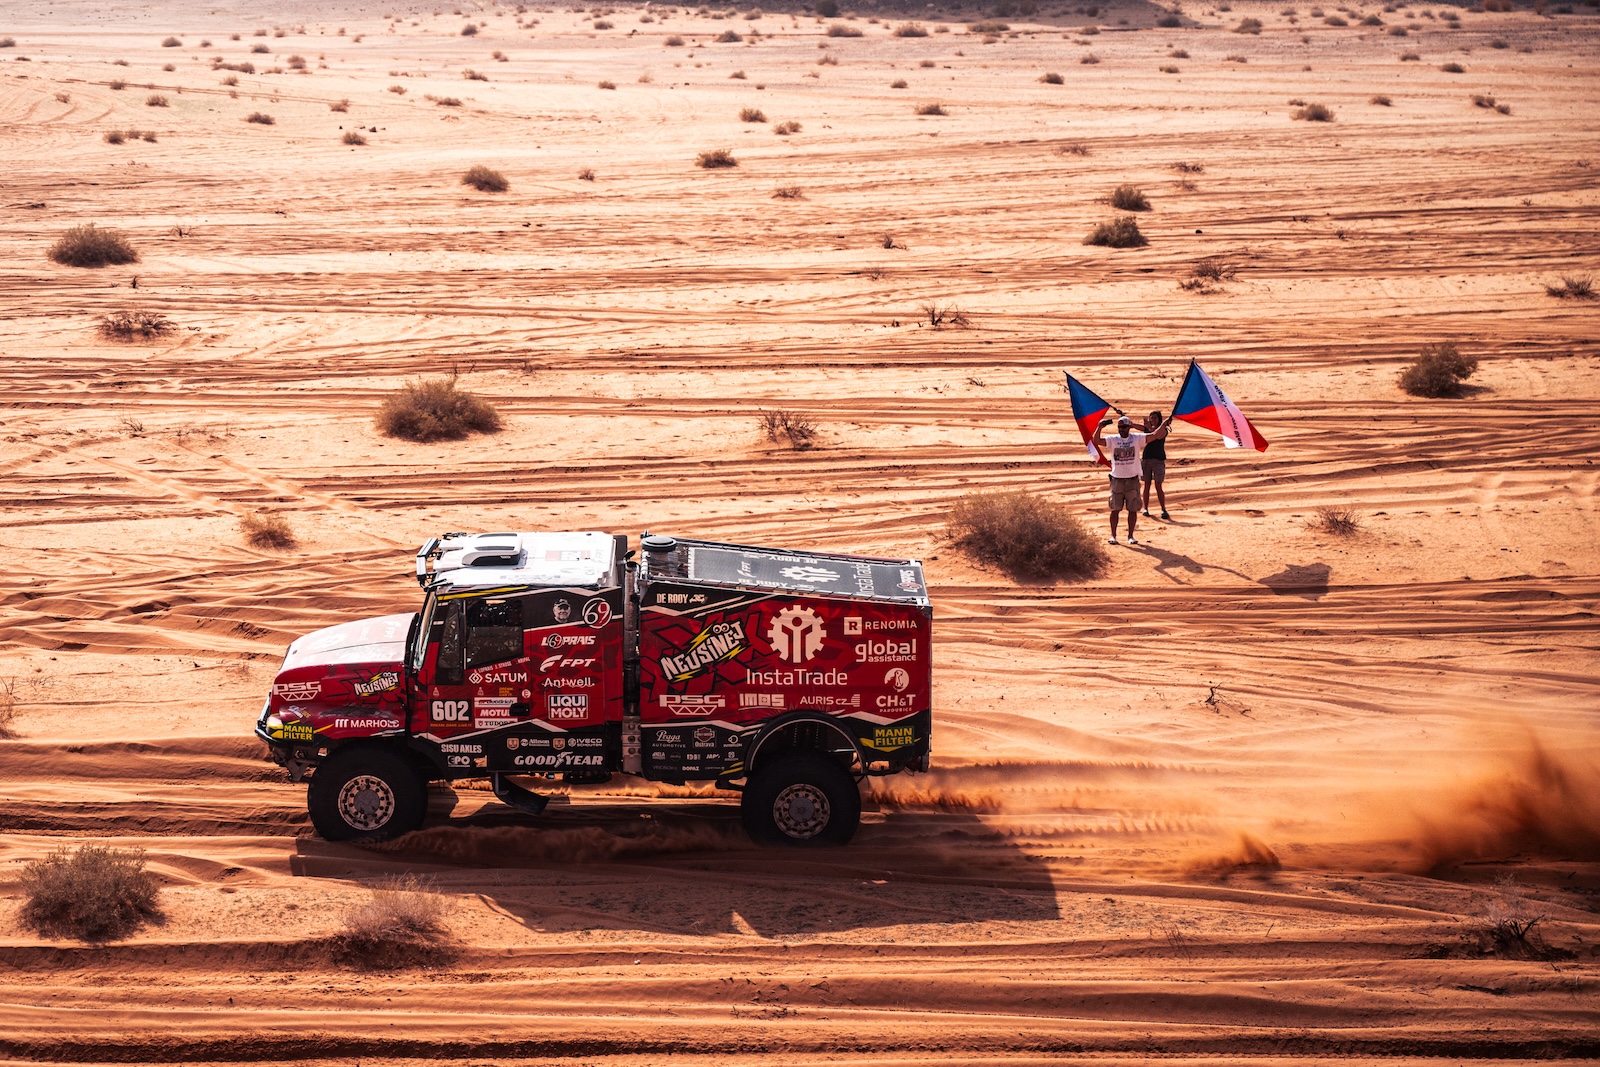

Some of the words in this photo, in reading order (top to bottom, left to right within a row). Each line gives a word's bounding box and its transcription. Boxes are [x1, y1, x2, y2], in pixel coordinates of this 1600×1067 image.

[656, 593, 666, 604] DE
[668, 593, 689, 604] ROOY
[583, 601, 611, 627] 69
[864, 619, 918, 630] RENOMIA
[855, 638, 917, 663] global
[560, 658, 596, 668] FPT
[868, 654, 917, 663] assistance
[485, 672, 528, 683] SATUM
[746, 667, 848, 686] InstaTrade
[550, 695, 586, 707] LIQUI
[799, 696, 834, 706] AURIS
[875, 693, 916, 708] CH&T
[431, 700, 470, 721] 602
[550, 707, 587, 719] MOLY
[283, 724, 313, 733] MANN
[874, 727, 913, 738] MANN
[283, 732, 313, 741] FILTER
[874, 737, 914, 747] FILTER
[441, 743, 460, 753] SISU
[460, 744, 482, 754] AXLES
[513, 754, 604, 766] GOODYEAR
